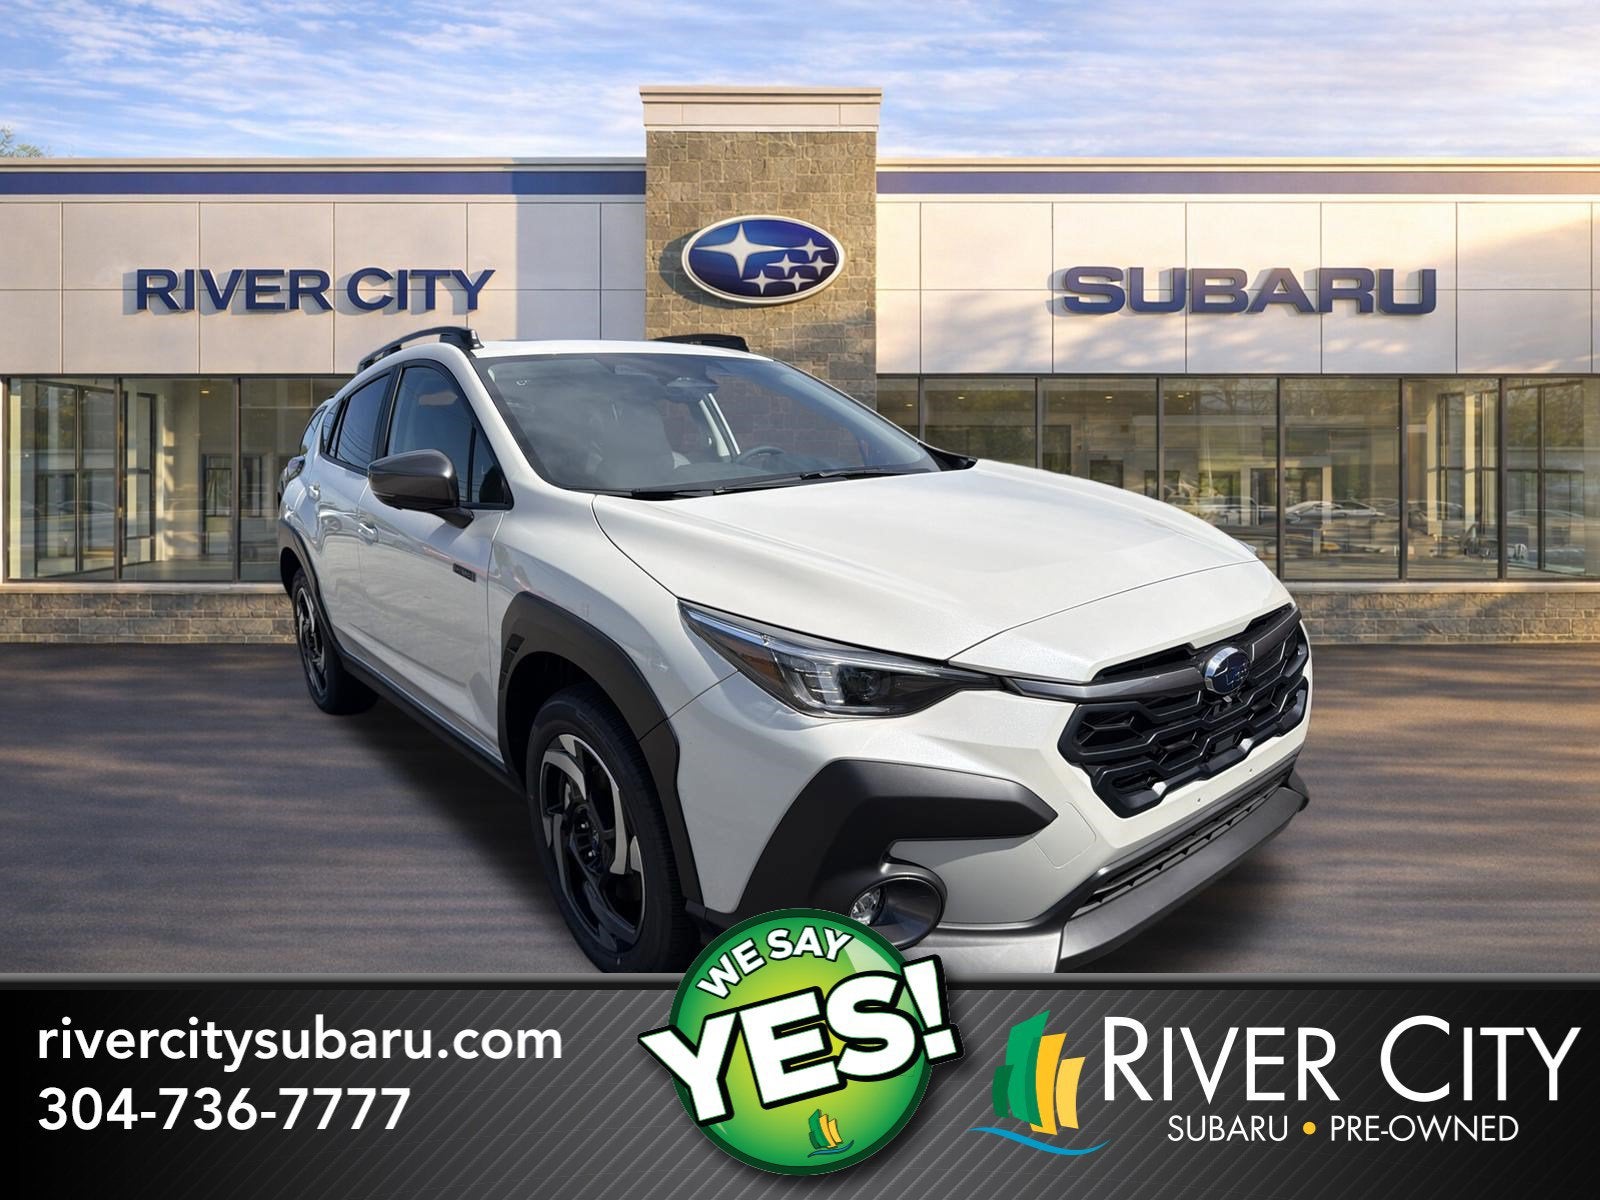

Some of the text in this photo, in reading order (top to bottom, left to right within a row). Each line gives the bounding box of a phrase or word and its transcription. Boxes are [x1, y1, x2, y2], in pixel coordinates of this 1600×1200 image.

[136, 267, 496, 311] RIVER CITY
[1063, 266, 1437, 314] SUBARU
